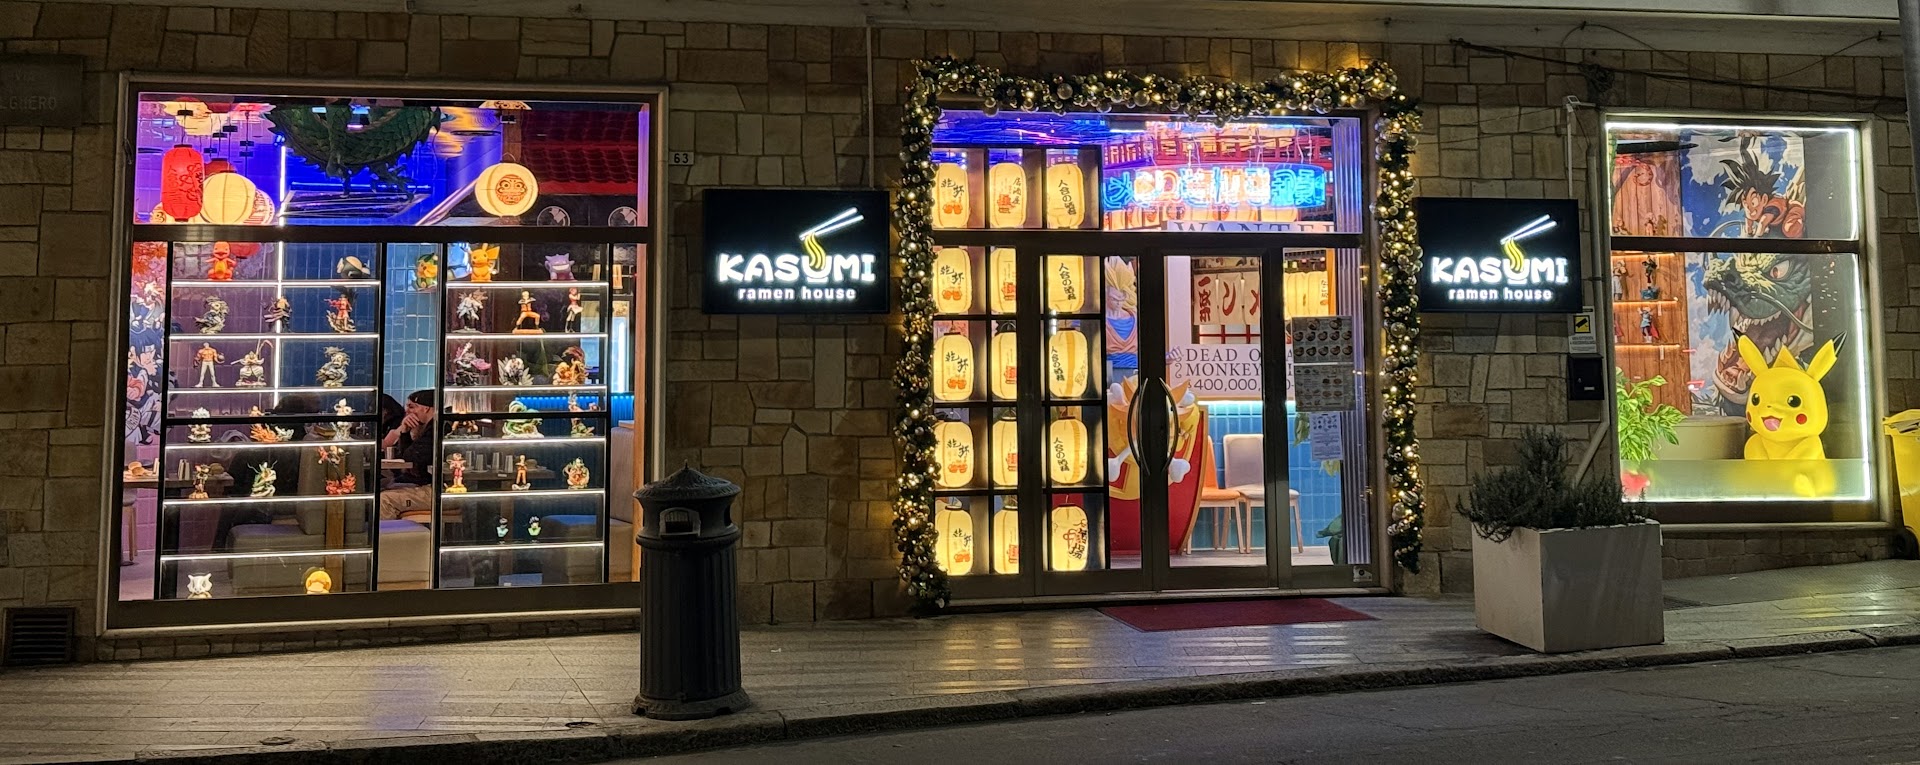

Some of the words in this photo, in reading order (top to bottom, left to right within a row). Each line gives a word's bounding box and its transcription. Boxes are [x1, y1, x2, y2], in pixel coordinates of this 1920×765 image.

[673, 152, 689, 164] 63
[718, 253, 876, 283] KASUMI
[1431, 257, 1568, 284] KASUMI
[738, 287, 795, 300] ramen
[801, 286, 857, 300] house
[1449, 289, 1498, 300] ramen
[1503, 287, 1553, 300] house
[1186, 348, 1238, 362] DEAD
[1186, 363, 1261, 376] MONKEY
